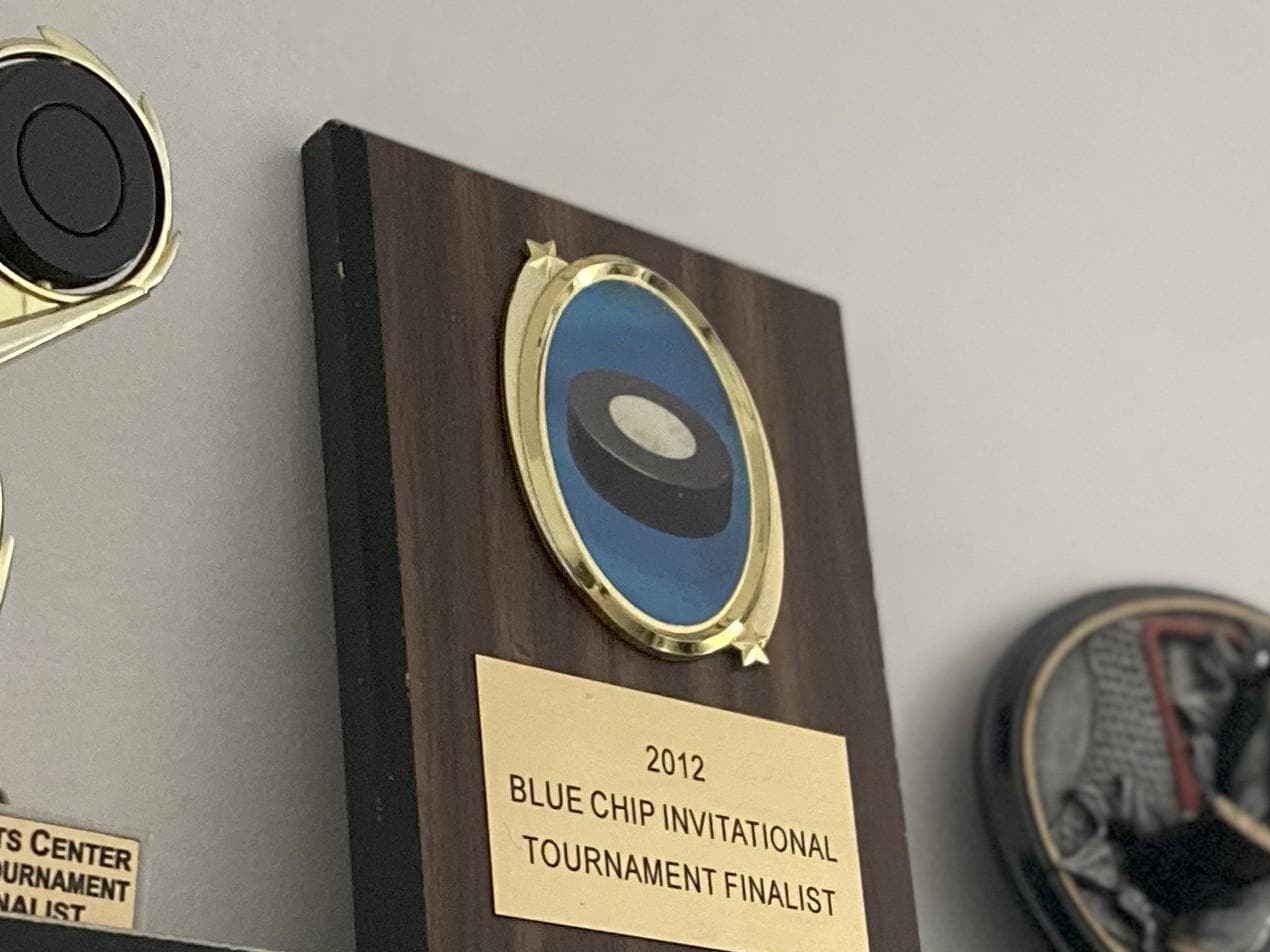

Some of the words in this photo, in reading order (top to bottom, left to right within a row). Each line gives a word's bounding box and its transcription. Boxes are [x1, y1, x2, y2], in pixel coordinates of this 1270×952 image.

[645, 744, 706, 783] 2012
[510, 773, 584, 815] BLUE
[590, 790, 656, 828] CHIP
[663, 803, 839, 863] INVITATIONAL
[0, 860, 131, 902] URNAMENT
[522, 834, 717, 896] TOURNAMENT
[724, 871, 836, 917] FINALIST
